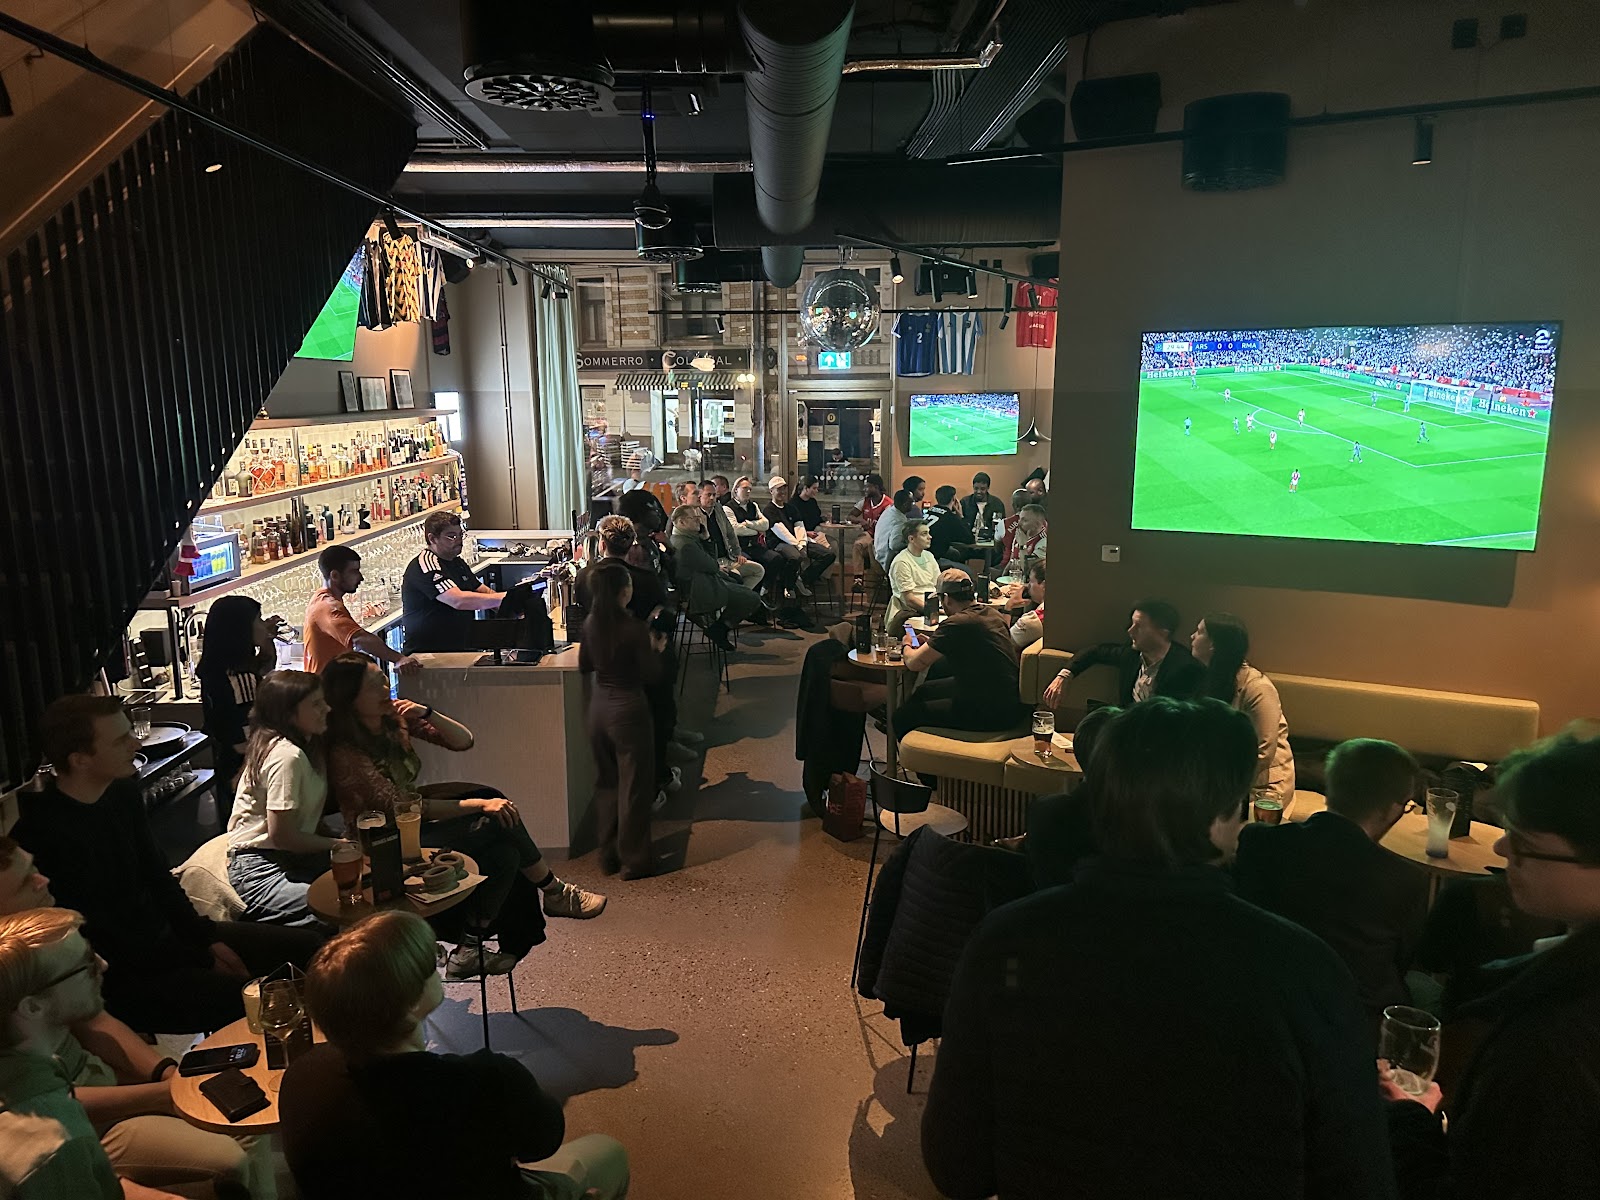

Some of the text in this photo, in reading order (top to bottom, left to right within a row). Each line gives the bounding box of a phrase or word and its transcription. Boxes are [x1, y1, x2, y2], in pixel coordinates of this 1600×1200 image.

[917, 332, 923, 343] 2
[1535, 329, 1549, 343] 2
[577, 351, 732, 369] SOMMERRO COLAL
[1234, 364, 1274, 373] Heineken
[1147, 370, 1189, 379] Heineken
